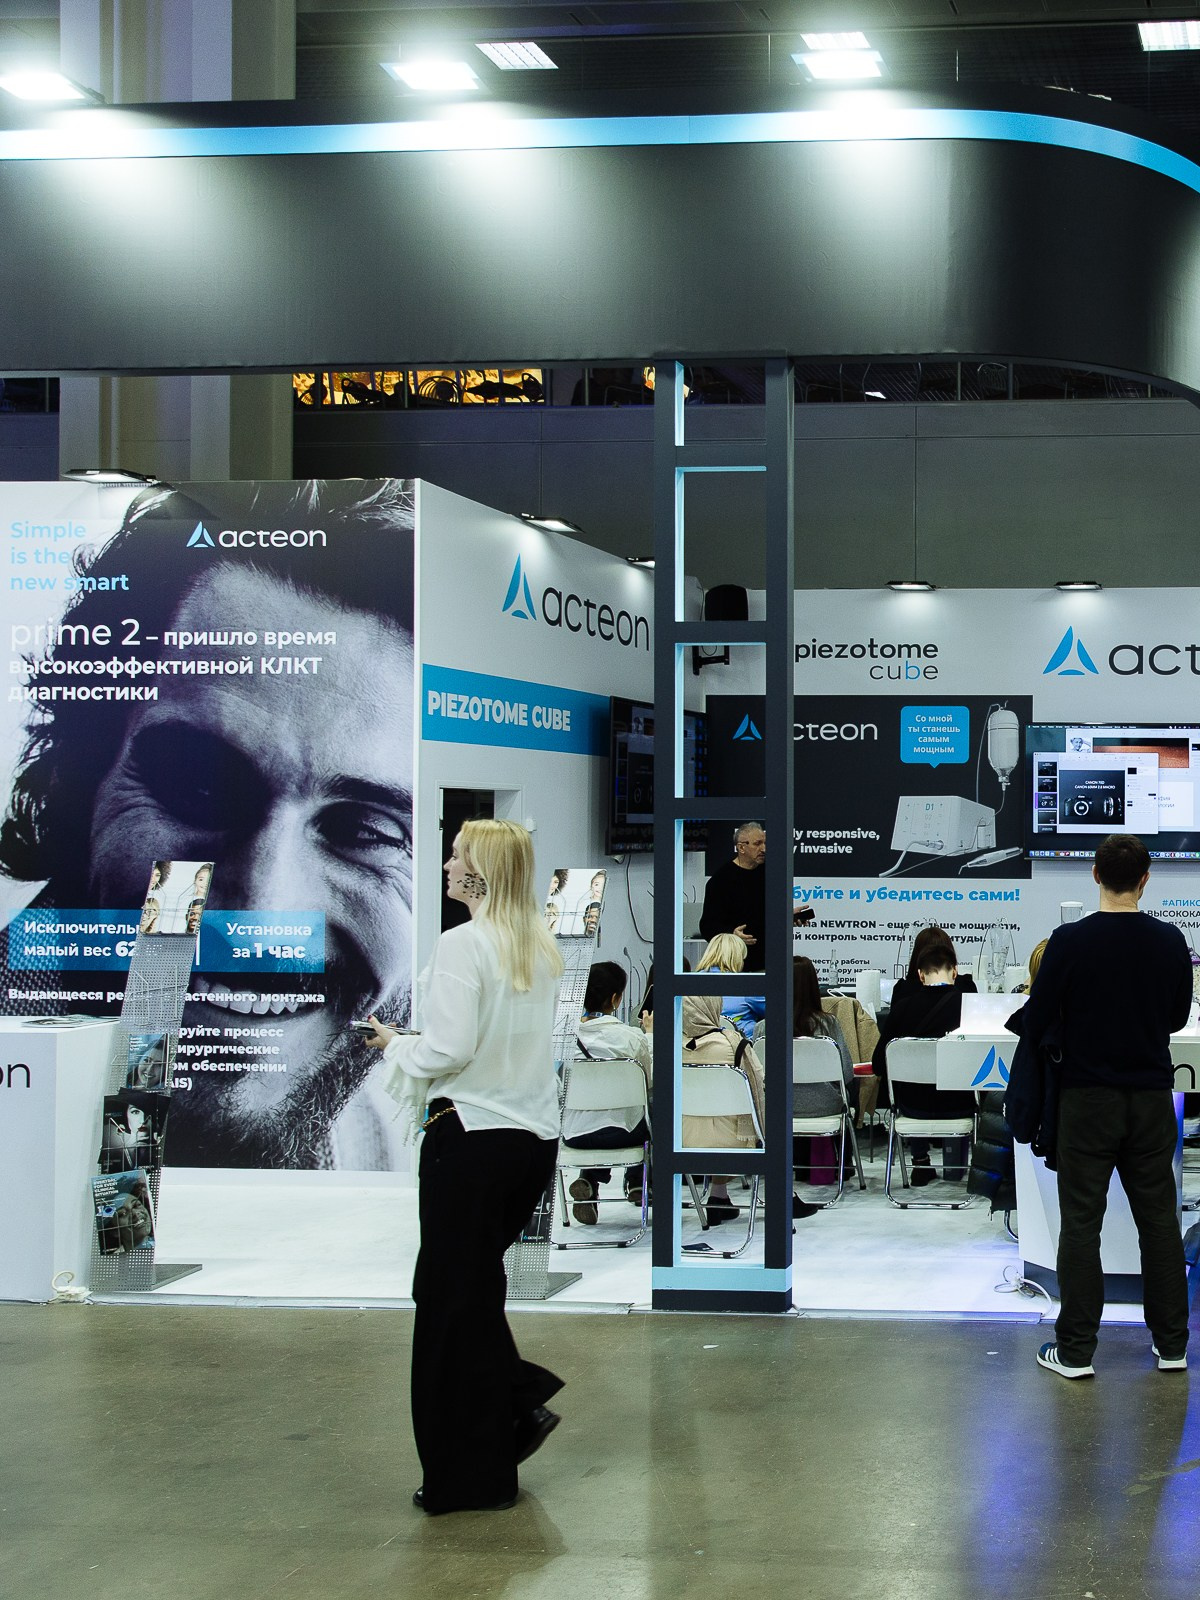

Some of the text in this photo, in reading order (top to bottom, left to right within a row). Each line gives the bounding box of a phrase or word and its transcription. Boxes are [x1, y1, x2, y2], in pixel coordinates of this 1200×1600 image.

[11, 521, 86, 542] Simple
[219, 527, 327, 547] acteon
[11, 547, 70, 565] is the
[10, 574, 129, 591] new smart
[542, 587, 650, 651] acteon
[12, 618, 112, 651] prime
[122, 618, 141, 646] 2
[164, 630, 258, 650] пришло
[265, 631, 337, 650] время
[795, 638, 939, 663] piezotome
[10, 656, 322, 679] высокоэффективной КЛКТ
[870, 660, 939, 680] cube
[8, 683, 158, 702] диагностики
[428, 690, 571, 732] PIEZOTOME CUBE
[915, 714, 953, 723] Со мной
[793, 723, 878, 741] cteon
[908, 726, 961, 734] ты станешь
[918, 736, 950, 744] самым
[913, 746, 955, 755] мощным
[806, 827, 880, 841] responsive,
[800, 841, 854, 854] invasive
[793, 886, 1020, 902] буйте и убедитесь сами!
[24, 921, 139, 934] Исключитель
[226, 922, 312, 936] Установка
[820, 920, 876, 928] NEWTRON
[887, 922, 910, 930] еще
[805, 934, 857, 943] контроль
[860, 934, 905, 942] частоты
[24, 943, 78, 957] малый
[84, 946, 111, 957] вес
[232, 943, 306, 959] за 1 час
[841, 957, 870, 966] работы
[8, 988, 103, 1001] Выдающееся
[184, 991, 325, 1003] астенного монтажа
[179, 1024, 284, 1040] руйте процесс
[177, 1043, 280, 1056] ирургические
[192, 1060, 287, 1072] обеспечении
